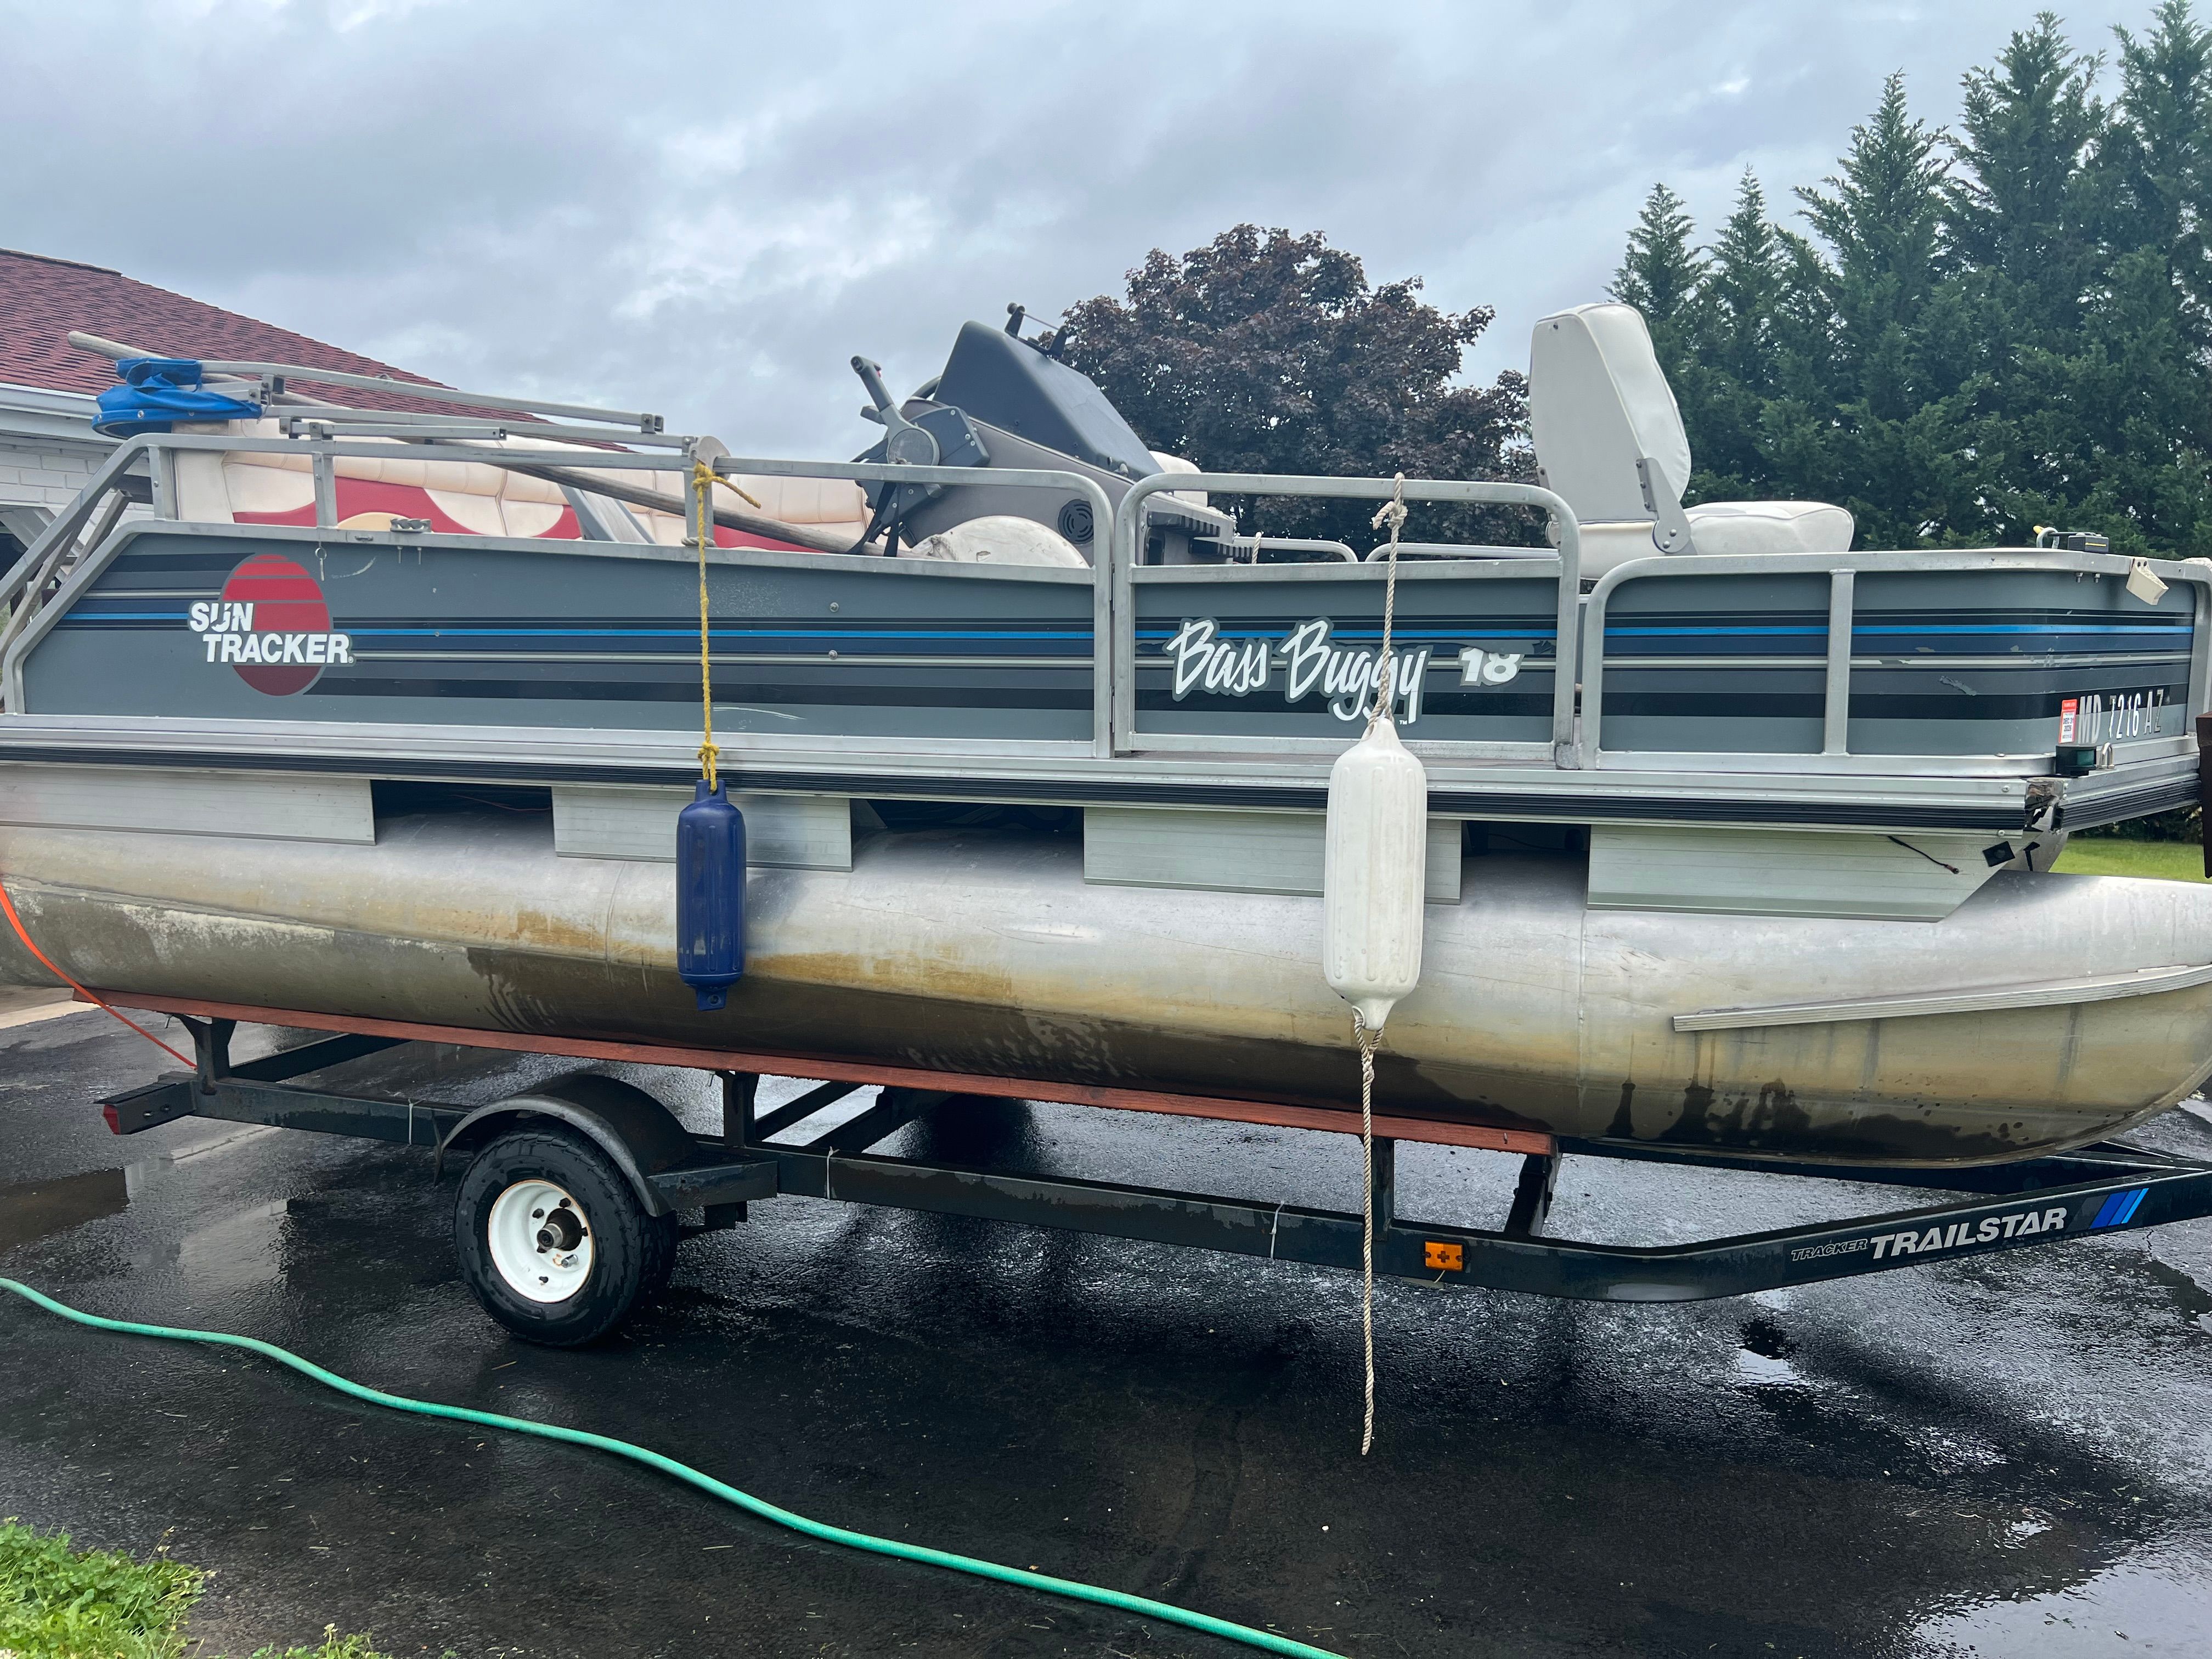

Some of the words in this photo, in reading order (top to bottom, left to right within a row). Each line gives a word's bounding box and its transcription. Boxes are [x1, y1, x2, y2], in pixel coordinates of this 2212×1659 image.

[190, 602, 255, 633] SUN
[202, 633, 350, 663] TRACKER
[1166, 619, 1269, 695] Bass
[1280, 619, 1427, 725] Buggy
[2078, 694, 2102, 744] MD
[2143, 688, 2164, 735] AZ
[1791, 1238, 1869, 1261] TRACKER
[1870, 1207, 2067, 1260] TRAILSTAR
